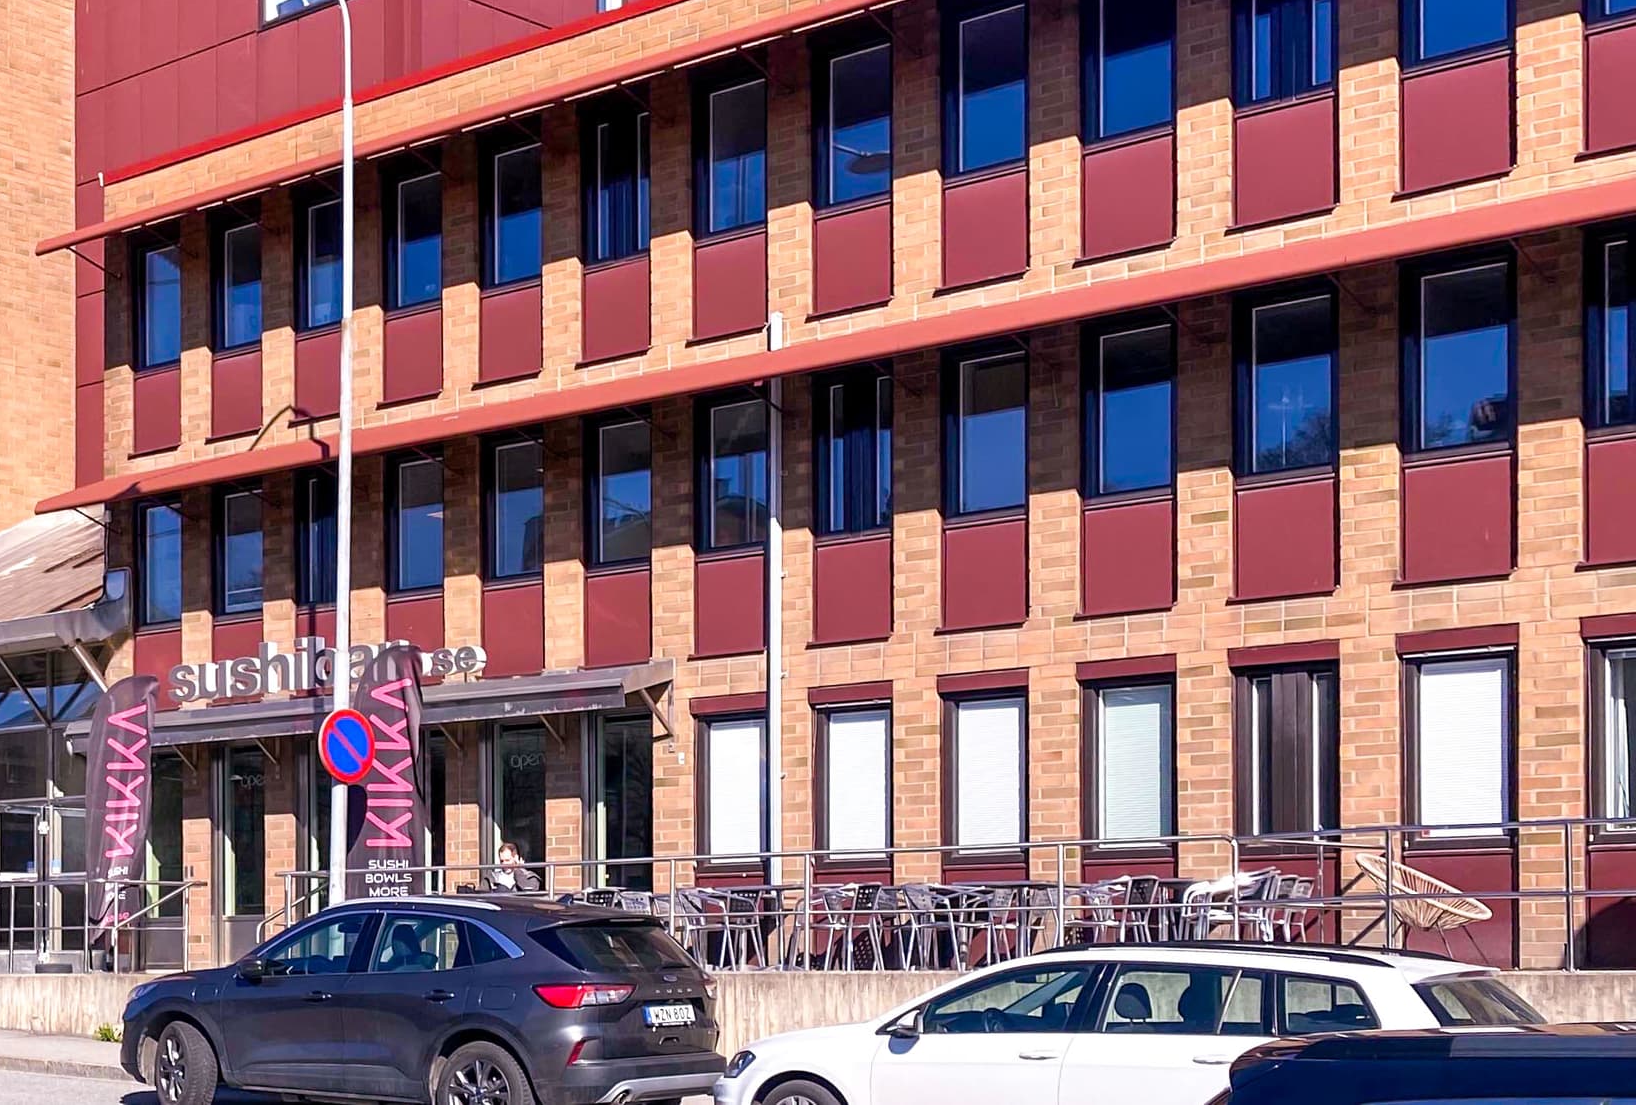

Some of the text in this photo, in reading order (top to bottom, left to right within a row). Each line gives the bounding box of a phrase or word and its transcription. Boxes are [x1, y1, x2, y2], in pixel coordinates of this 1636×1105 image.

[368, 859, 410, 870] SUSHI
[365, 873, 413, 884] BOWLS
[369, 886, 409, 897] MORE
